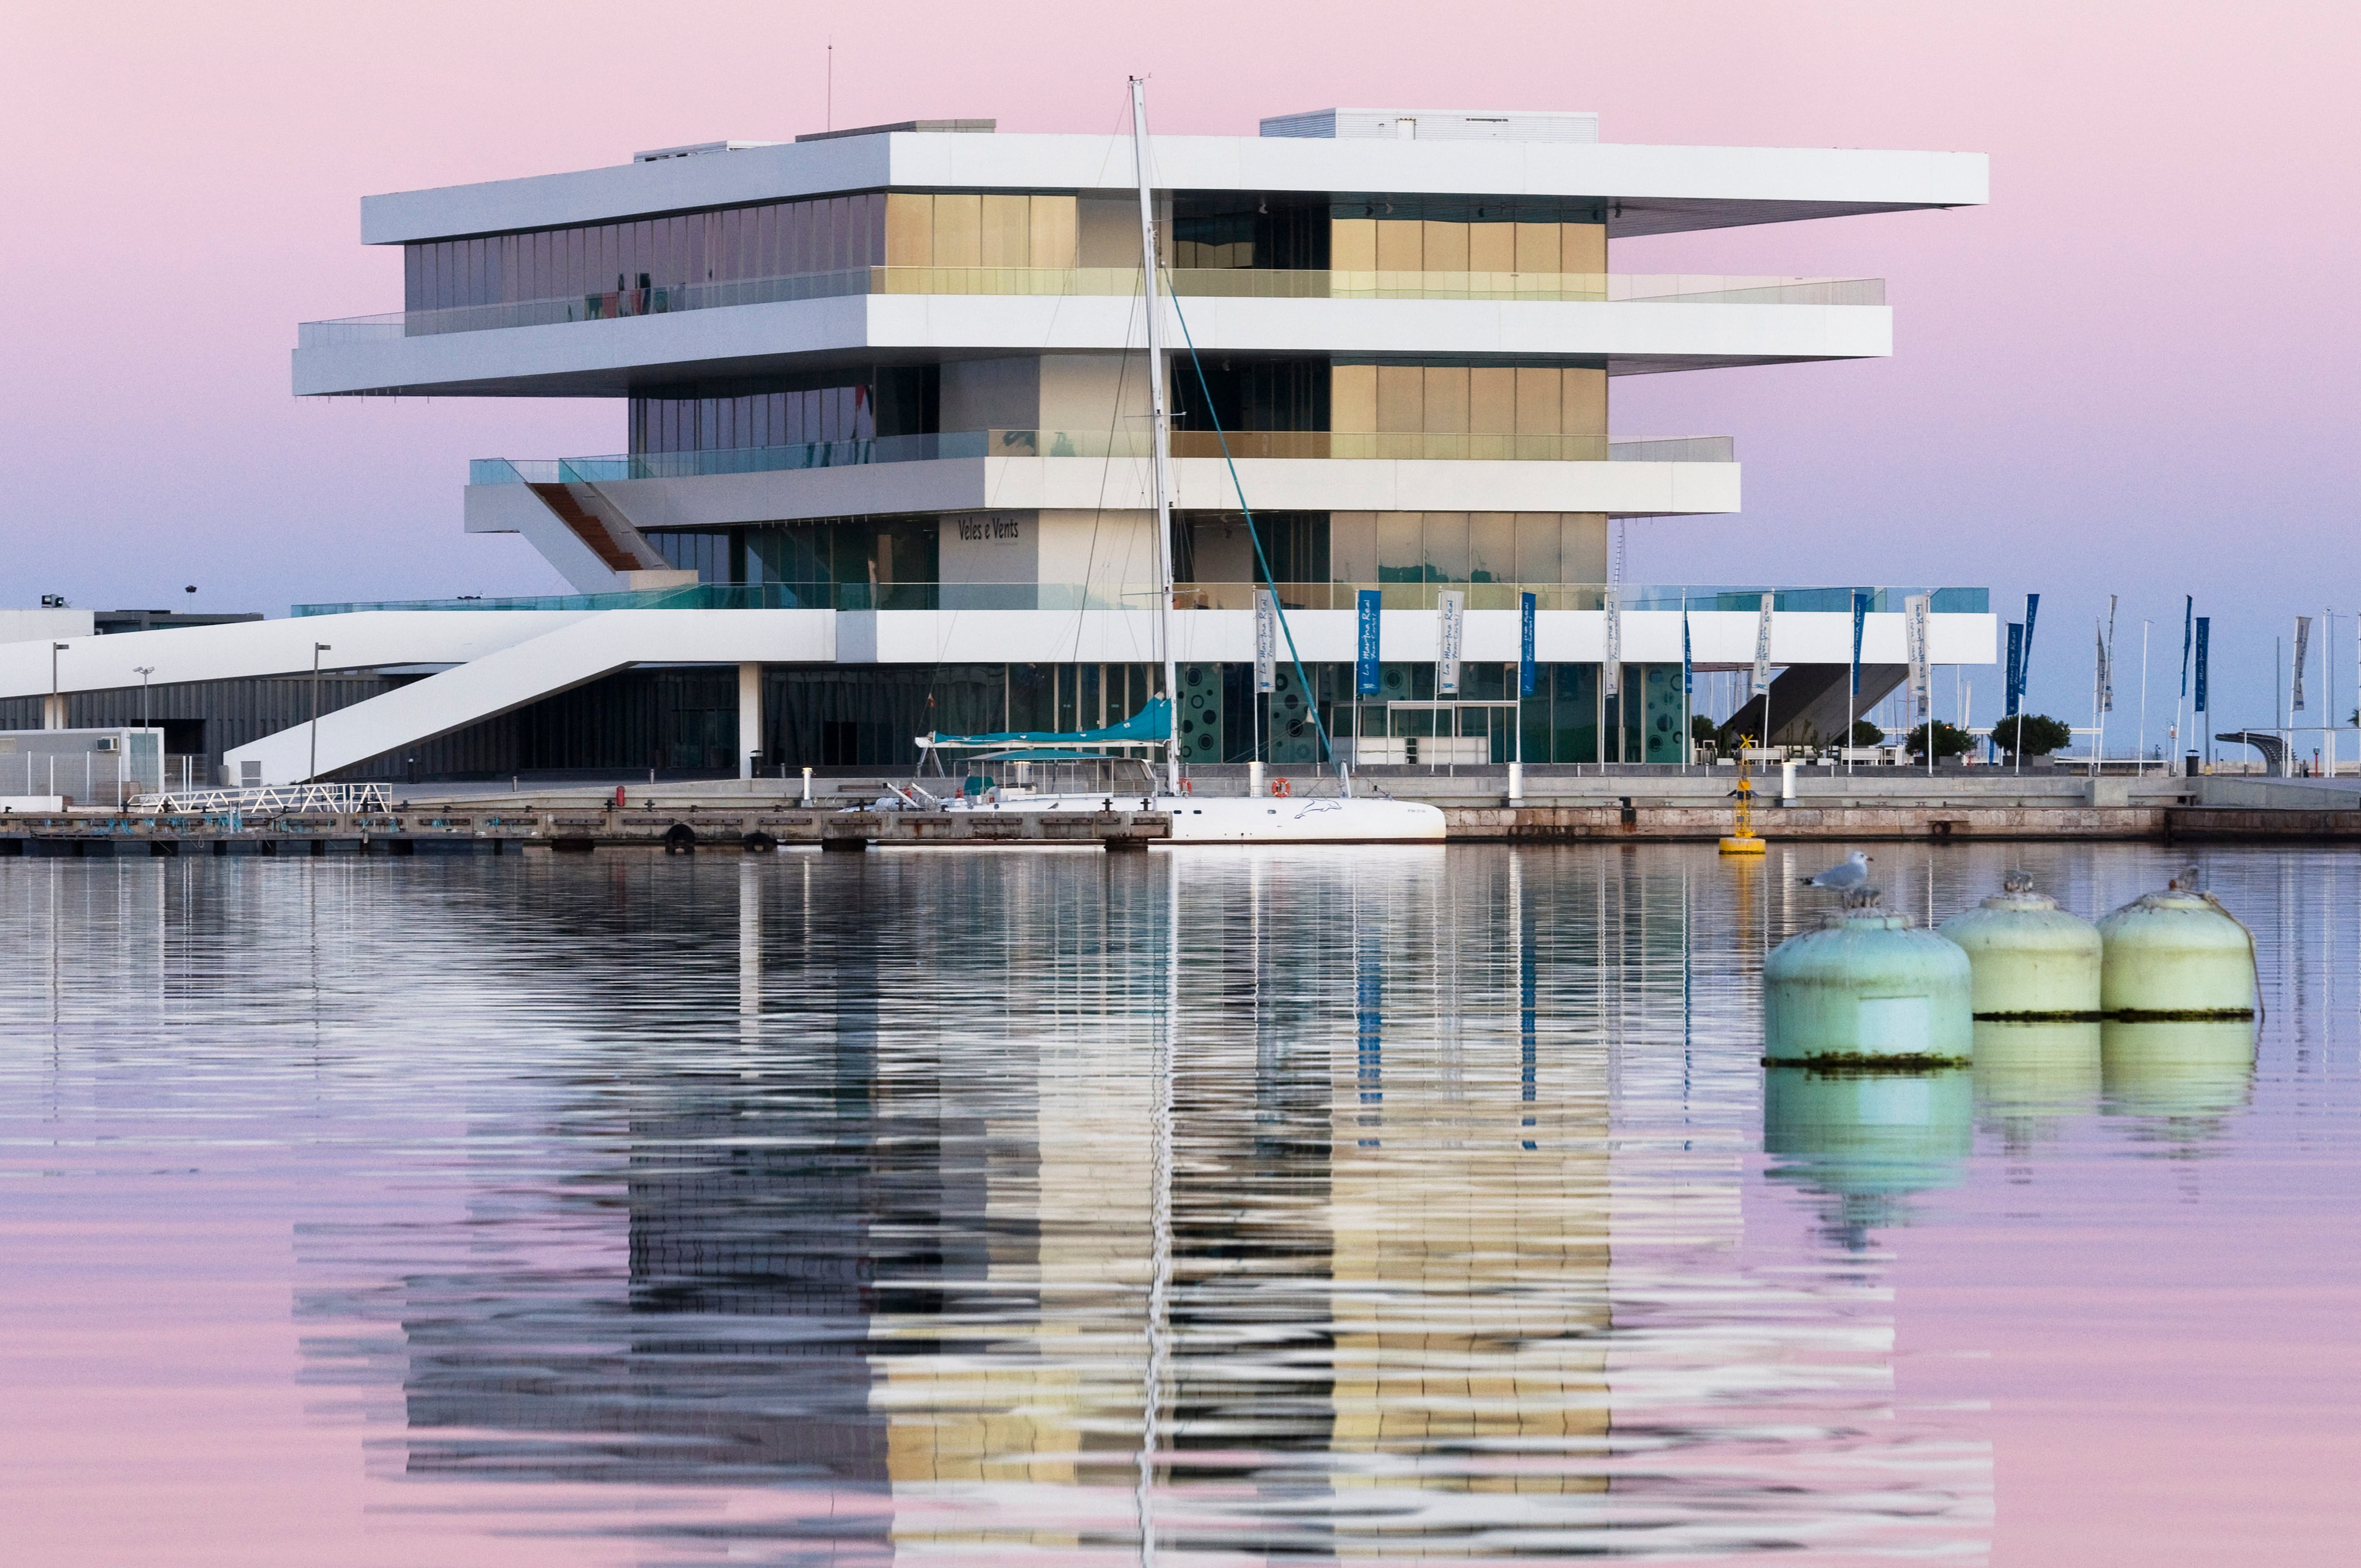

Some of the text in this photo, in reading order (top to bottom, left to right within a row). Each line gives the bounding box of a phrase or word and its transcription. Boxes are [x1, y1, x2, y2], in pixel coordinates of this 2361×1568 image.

[959, 517, 1019, 540] Veles e Vents
[1258, 599, 1267, 674] La Marina Real
[1361, 600, 1371, 676] La Marina Real
[1443, 600, 1453, 675] La Marina Real
